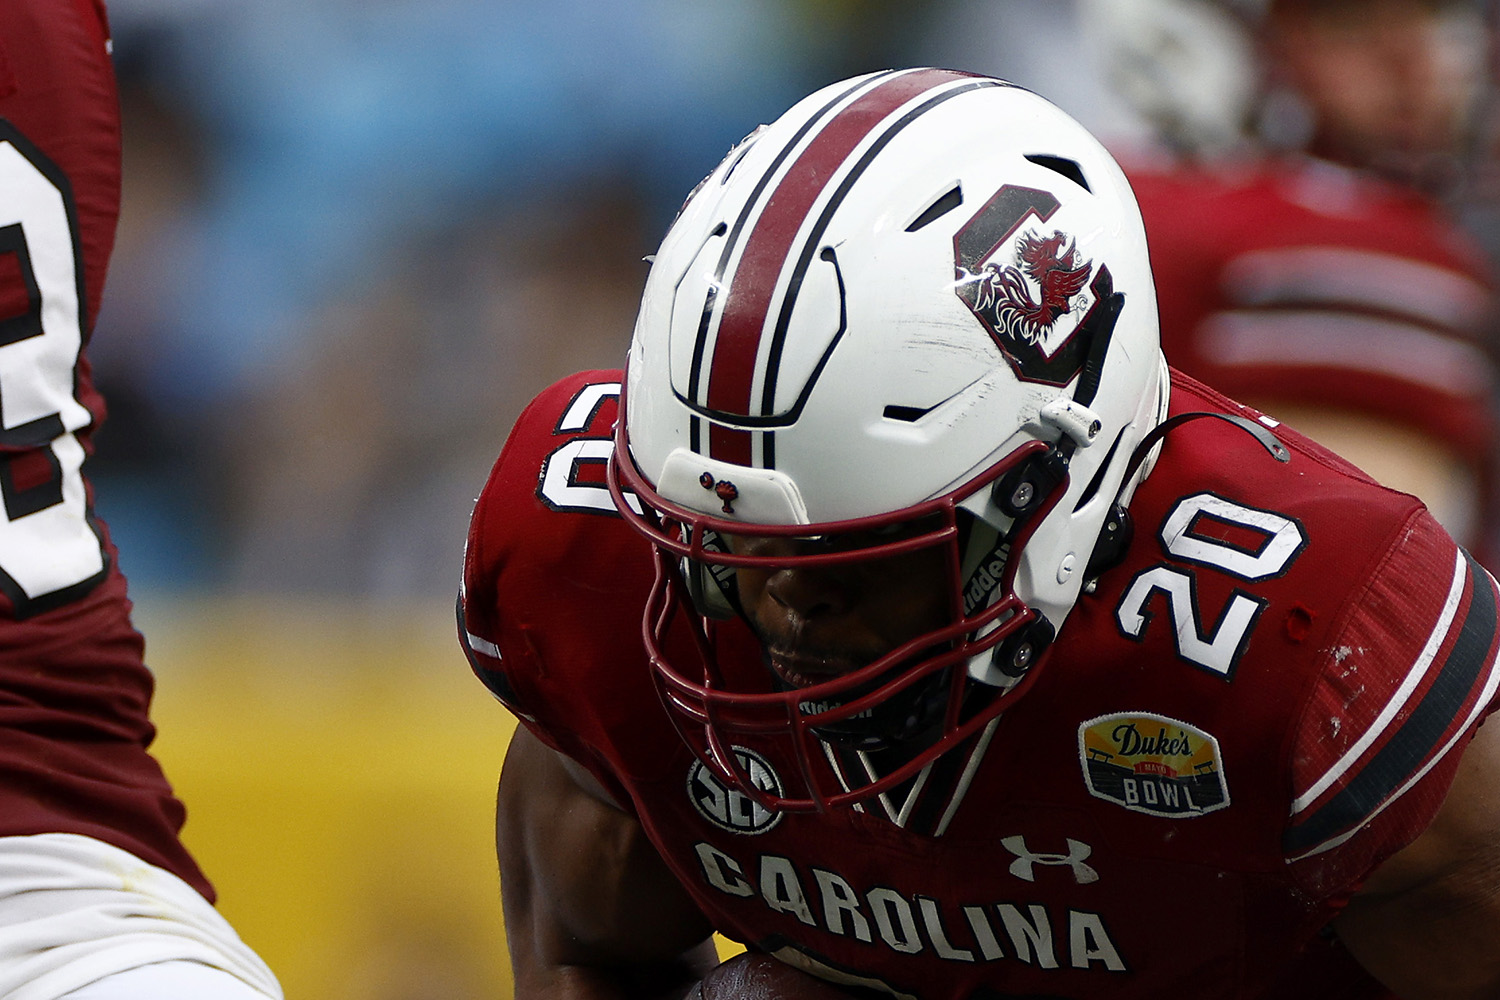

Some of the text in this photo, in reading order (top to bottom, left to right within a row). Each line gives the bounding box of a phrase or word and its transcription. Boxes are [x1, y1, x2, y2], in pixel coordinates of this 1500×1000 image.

[1115, 491, 1309, 682] 20
[1123, 778, 1202, 810] BOWL
[1144, 763, 1167, 775] MAYO
[694, 842, 1127, 972] CAROLINA
